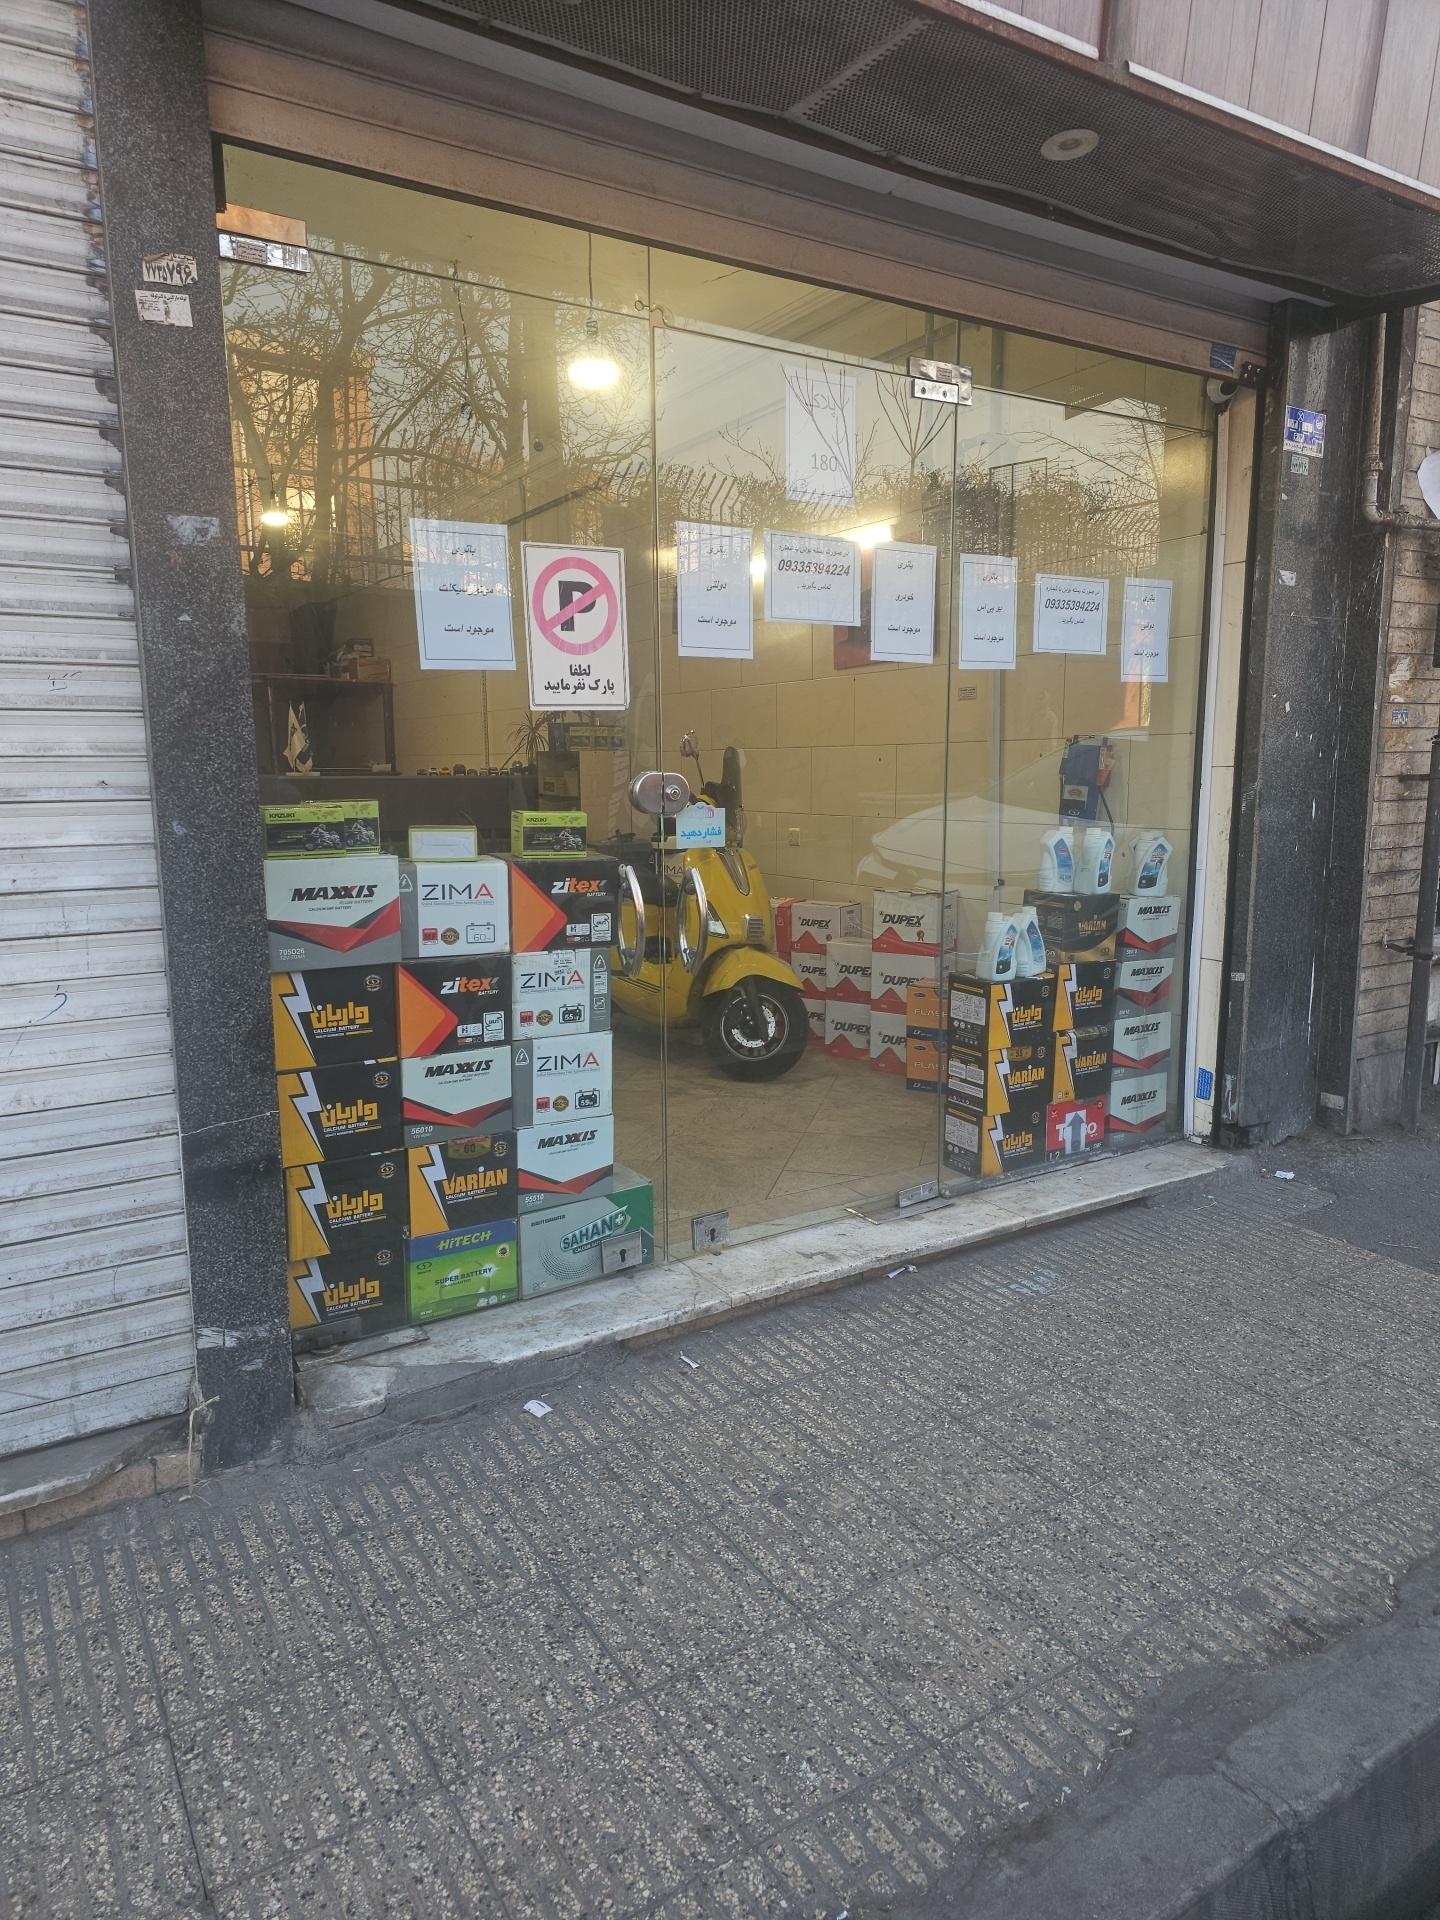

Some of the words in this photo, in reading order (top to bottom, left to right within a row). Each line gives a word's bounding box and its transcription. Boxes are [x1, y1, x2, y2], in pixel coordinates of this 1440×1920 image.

[811, 453, 838, 472] 180
[778, 559, 851, 577] 09335394224
[897, 560, 914, 570] باتری
[706, 580, 727, 591] دولتی
[817, 583, 832, 591] تماس
[895, 592, 914, 602] خودرو
[558, 580, 597, 632] P
[1044, 598, 1101, 612] 09335394224
[697, 615, 713, 624] است
[714, 618, 737, 627] موجود
[444, 624, 464, 633] است
[466, 626, 494, 636] موجود
[888, 624, 901, 632] است
[902, 625, 921, 635] موجود
[973, 633, 987, 641] است
[987, 634, 1004, 643] موجود
[569, 664, 591, 677] لطفا
[544, 679, 586, 695] نفرمایید
[588, 678, 615, 695] پارک
[680, 829, 702, 840] دهید
[701, 826, 722, 839] فشار
[421, 883, 494, 900] ZIMA
[551, 877, 603, 894] zitex
[291, 884, 378, 902] MAXXIS
[1137, 905, 1172, 915] MAXXIS
[800, 918, 831, 930] DUPEX
[882, 912, 926, 928] DUPEX
[801, 966, 826, 976] DUPE
[839, 964, 872, 977] DUPE
[1130, 966, 1165, 977] MAXXIS
[520, 969, 584, 989] ZIMA
[440, 977, 496, 995] zitex
[309, 1001, 370, 1029] واریان
[1123, 1021, 1160, 1036] MAXXIS
[536, 1051, 600, 1072] ZIMA
[424, 1059, 494, 1078] MAXXIS
[1120, 1089, 1158, 1106] MAXXIS
[320, 1098, 378, 1128] واریان
[347, 1121, 369, 1129] BATTERY
[411, 1125, 433, 1135] 56010
[537, 1129, 598, 1150] MAXXIS
[445, 1192, 466, 1200] CALCIUM
[325, 1189, 384, 1219] واریان
[562, 1215, 614, 1251] SAHAN
[434, 1275, 459, 1286] SUPER
[460, 1266, 493, 1279] BATTERY
[323, 1276, 380, 1307] واریان
